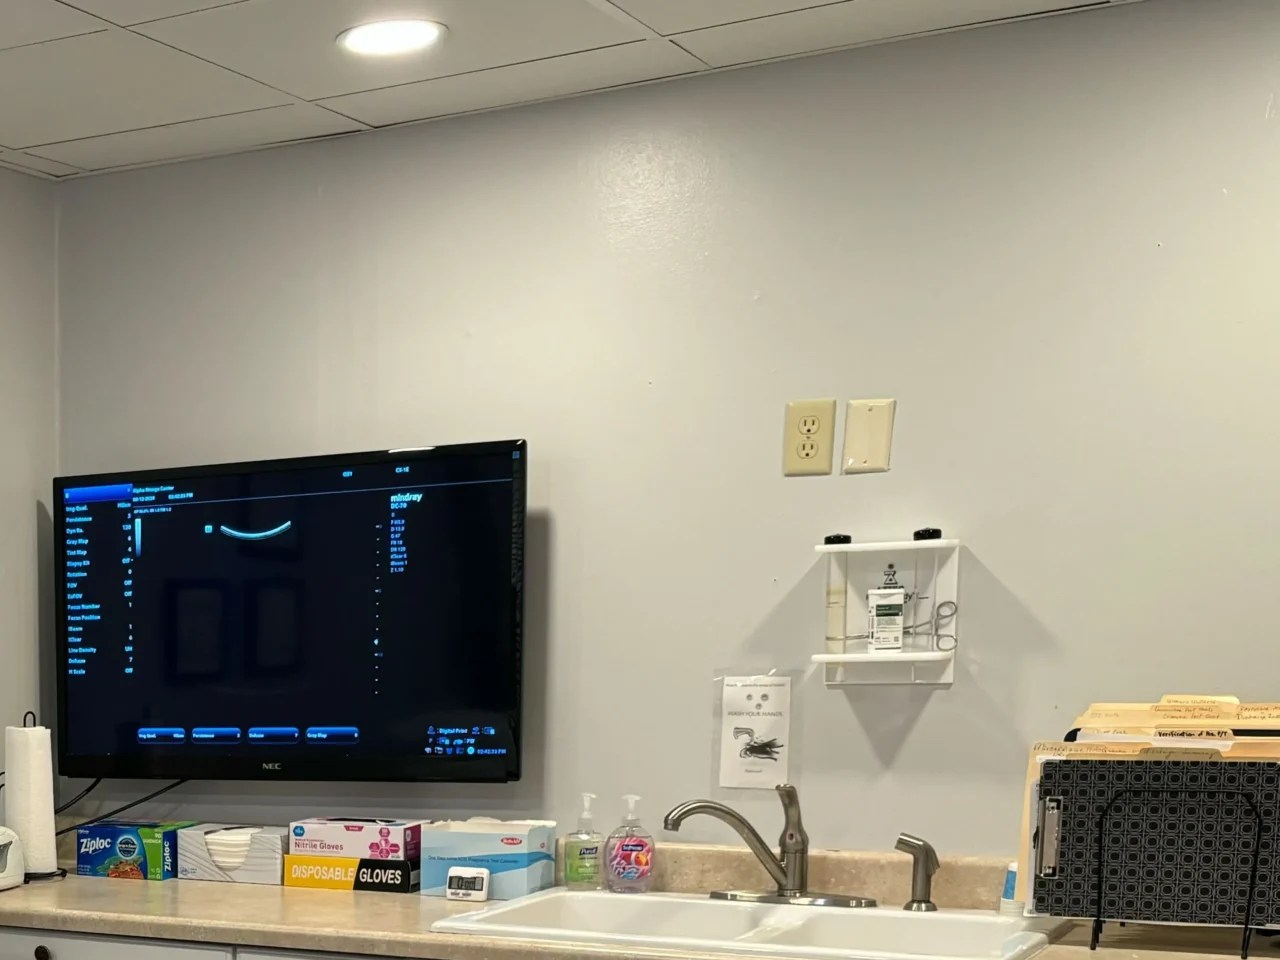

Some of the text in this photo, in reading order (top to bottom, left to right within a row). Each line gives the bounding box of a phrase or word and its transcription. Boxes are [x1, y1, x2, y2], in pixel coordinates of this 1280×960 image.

[390, 492, 423, 502] mindray
[262, 762, 282, 770] NEC
[80, 837, 112, 855] Ziploc
[294, 841, 344, 851] Nitrile Gloves
[164, 841, 172, 872] Ziploc
[291, 864, 402, 884] DISPOSABLE GLOVES
